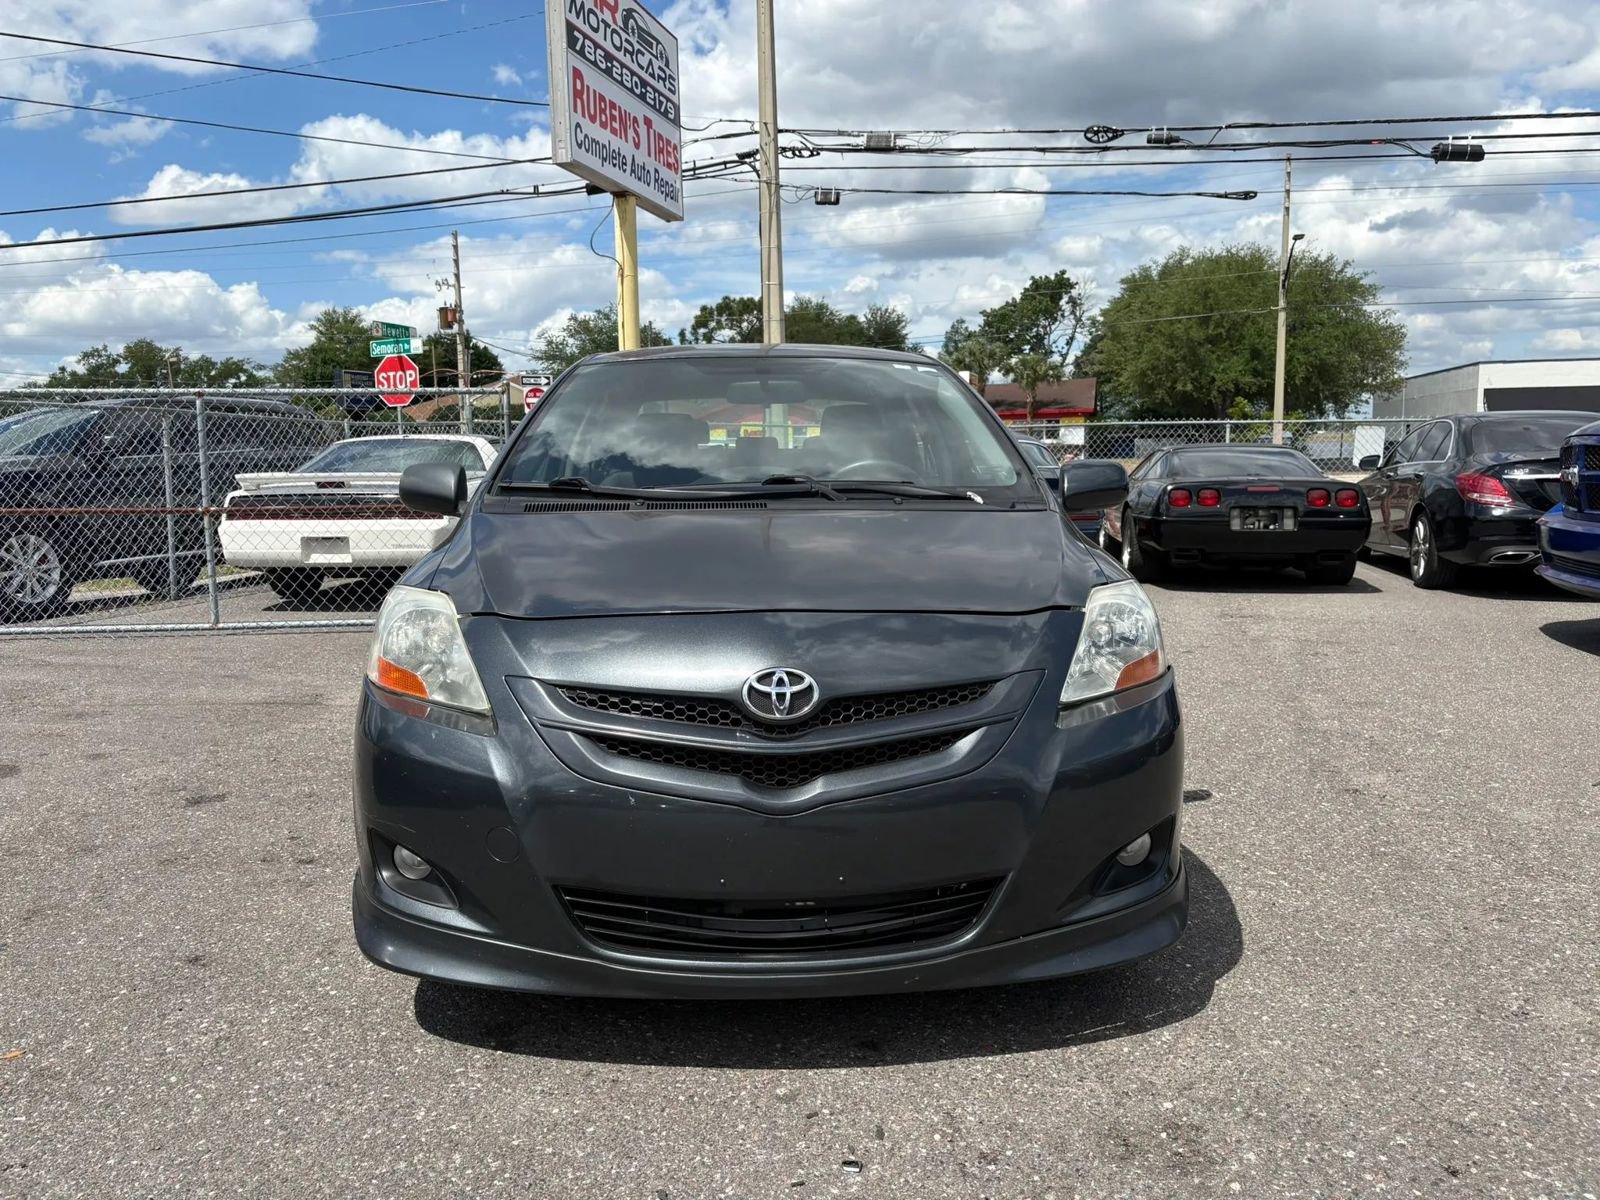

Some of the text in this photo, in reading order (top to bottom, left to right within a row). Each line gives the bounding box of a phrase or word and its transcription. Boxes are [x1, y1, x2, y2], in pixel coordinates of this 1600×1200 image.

[569, 0, 677, 95] MOTORCARS
[573, 31, 675, 119] 786-280-2179
[572, 65, 679, 175] RUBEN'S TIRES
[574, 122, 680, 203] Complete Auto Repair
[372, 342, 404, 355] Semoran
[379, 370, 416, 389] STOP
